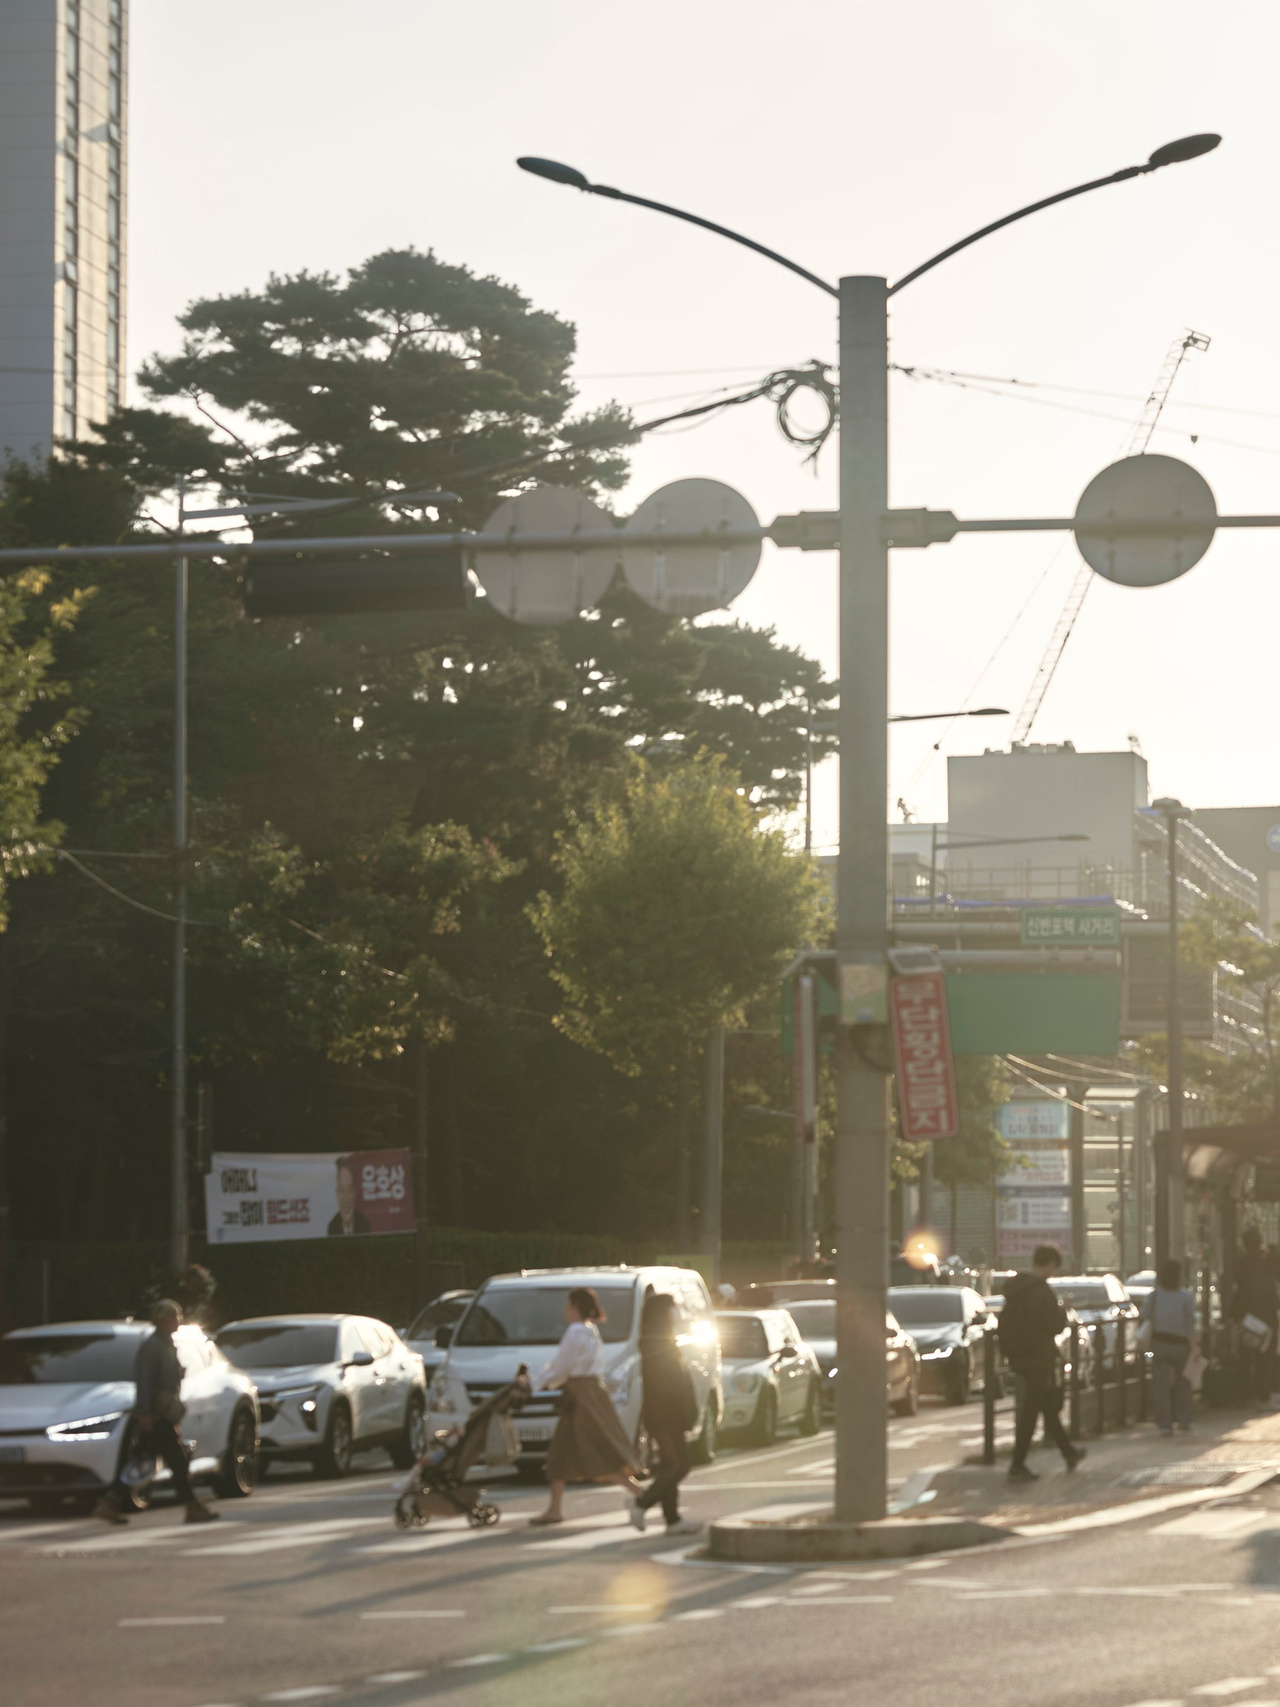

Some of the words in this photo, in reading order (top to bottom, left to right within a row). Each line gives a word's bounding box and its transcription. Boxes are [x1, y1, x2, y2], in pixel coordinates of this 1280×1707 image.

[1026, 916, 1076, 938] 신반포역
[1077, 916, 1114, 937] 사거리
[896, 981, 950, 1132] 무단횡단금지
